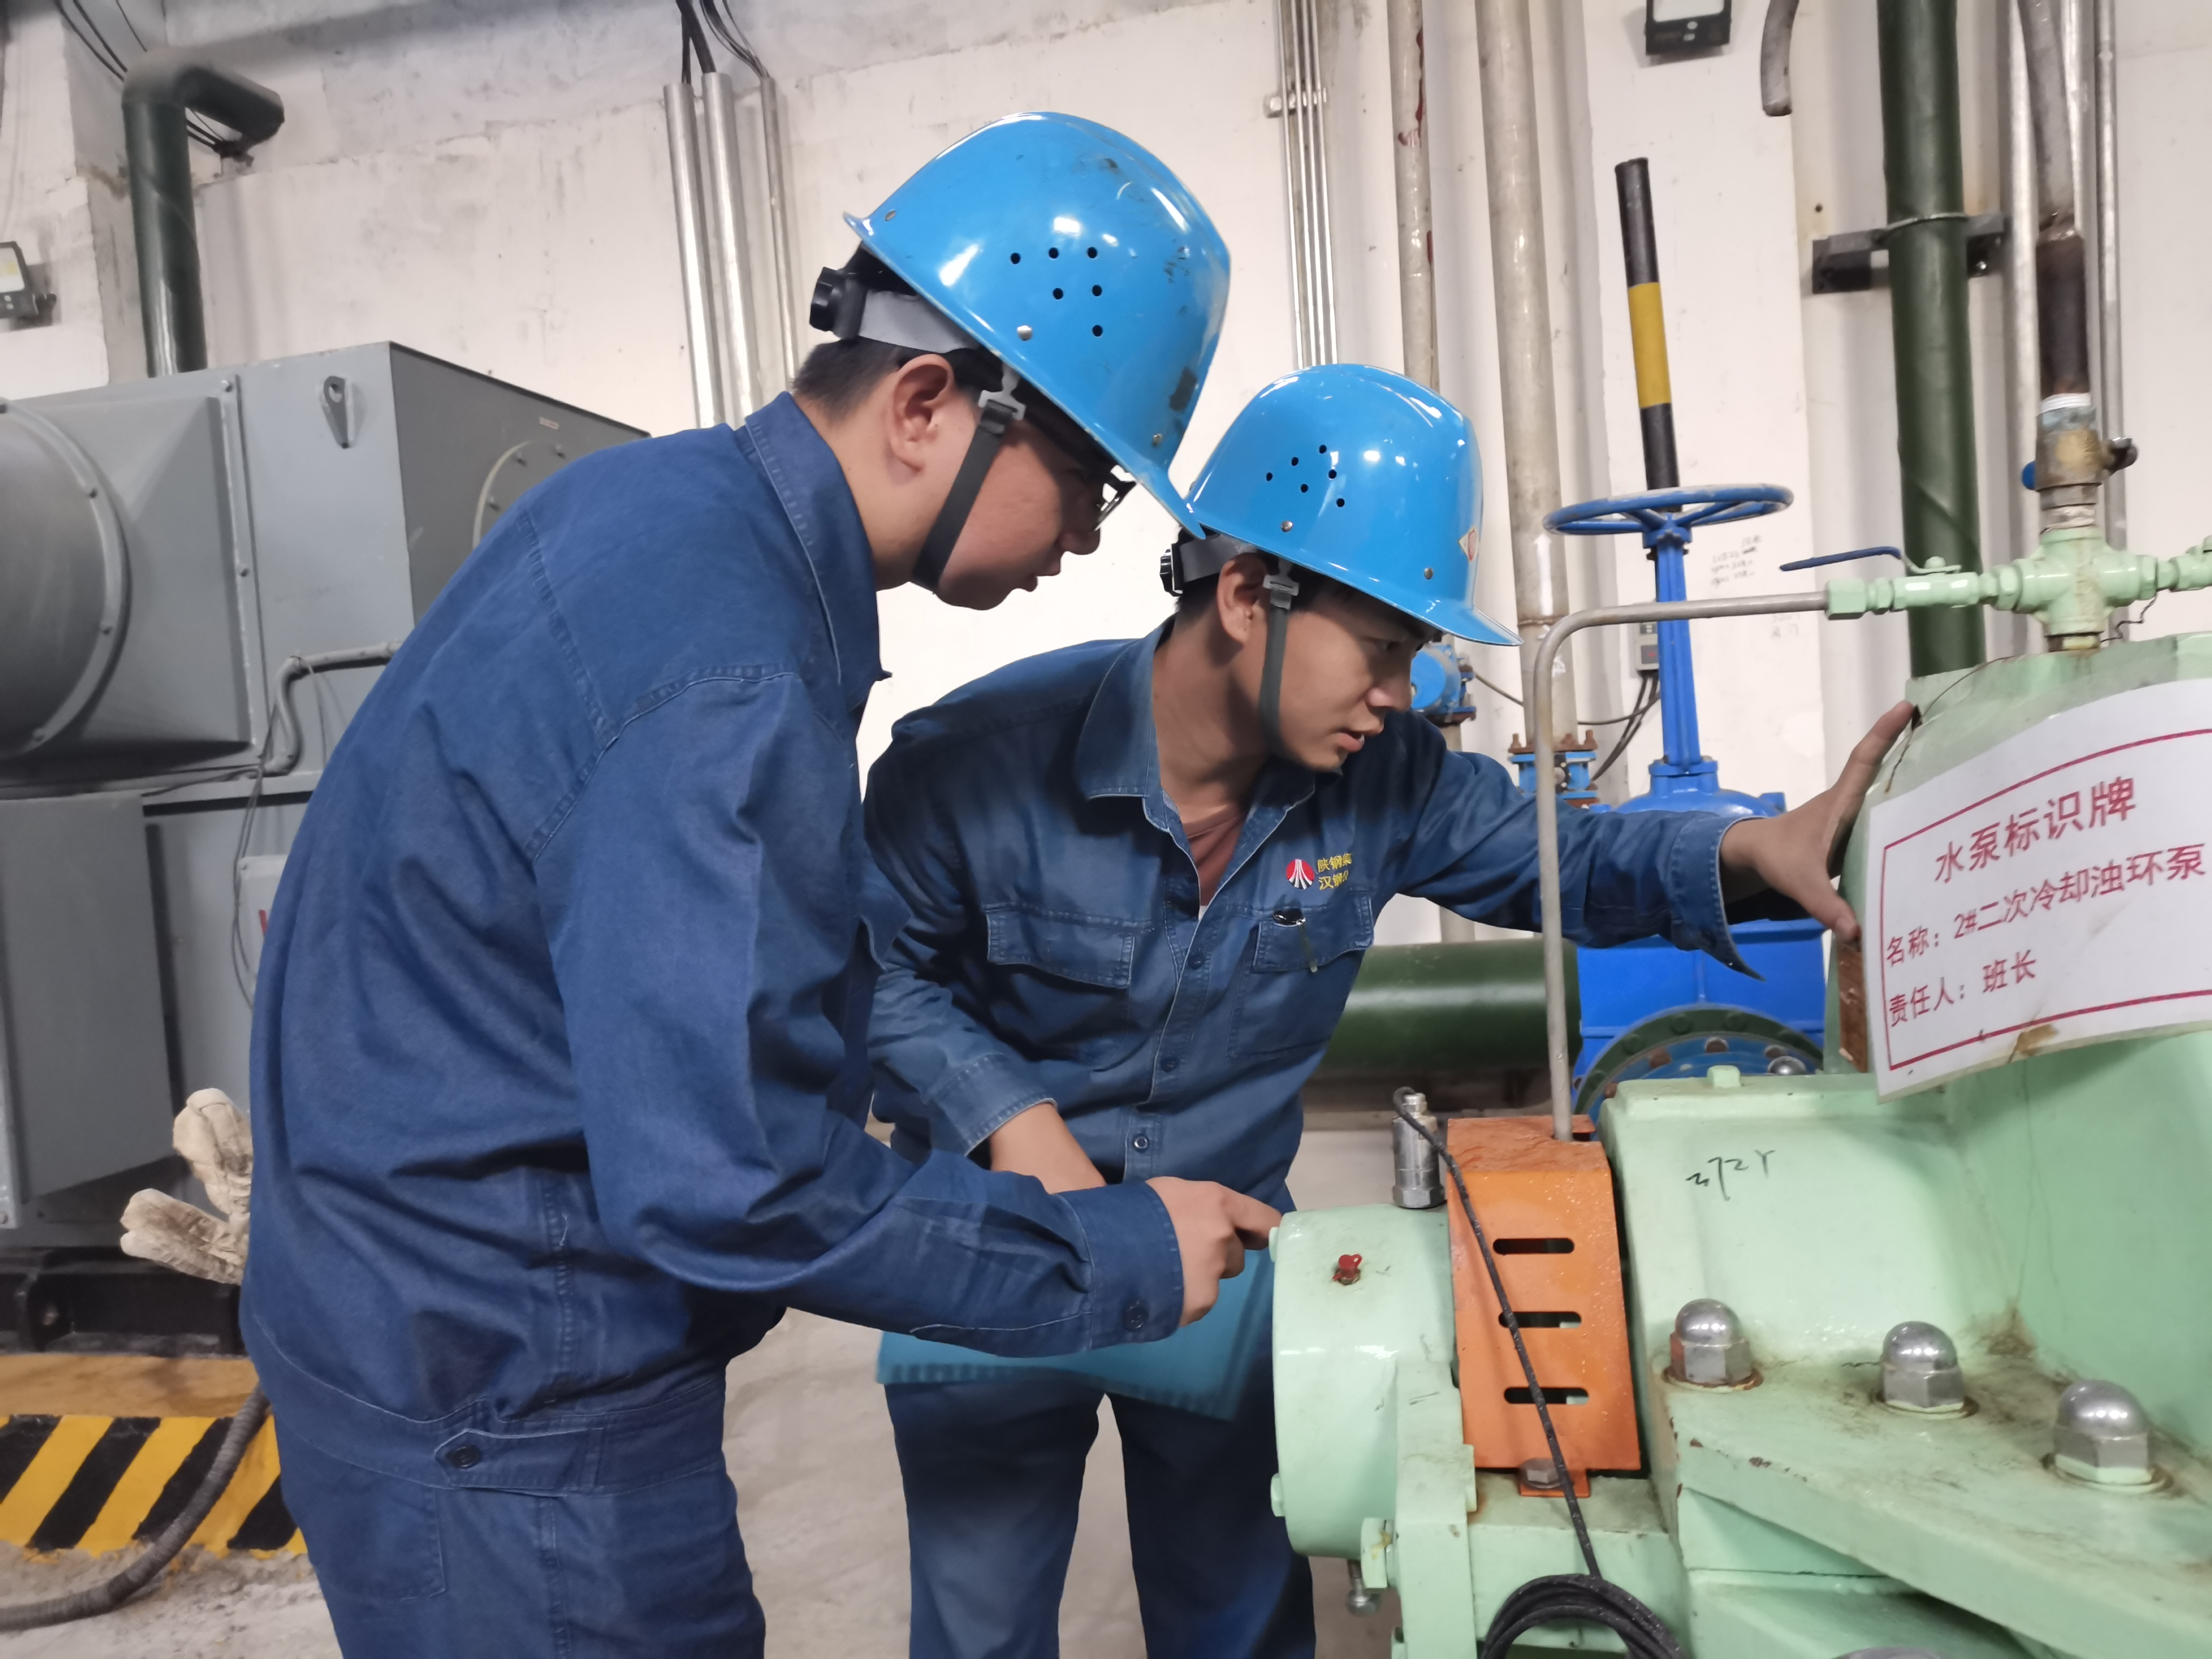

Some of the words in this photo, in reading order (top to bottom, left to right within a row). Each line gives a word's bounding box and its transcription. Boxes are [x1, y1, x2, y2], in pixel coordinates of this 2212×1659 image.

[1934, 776, 2136, 884] 水泵标识牌
